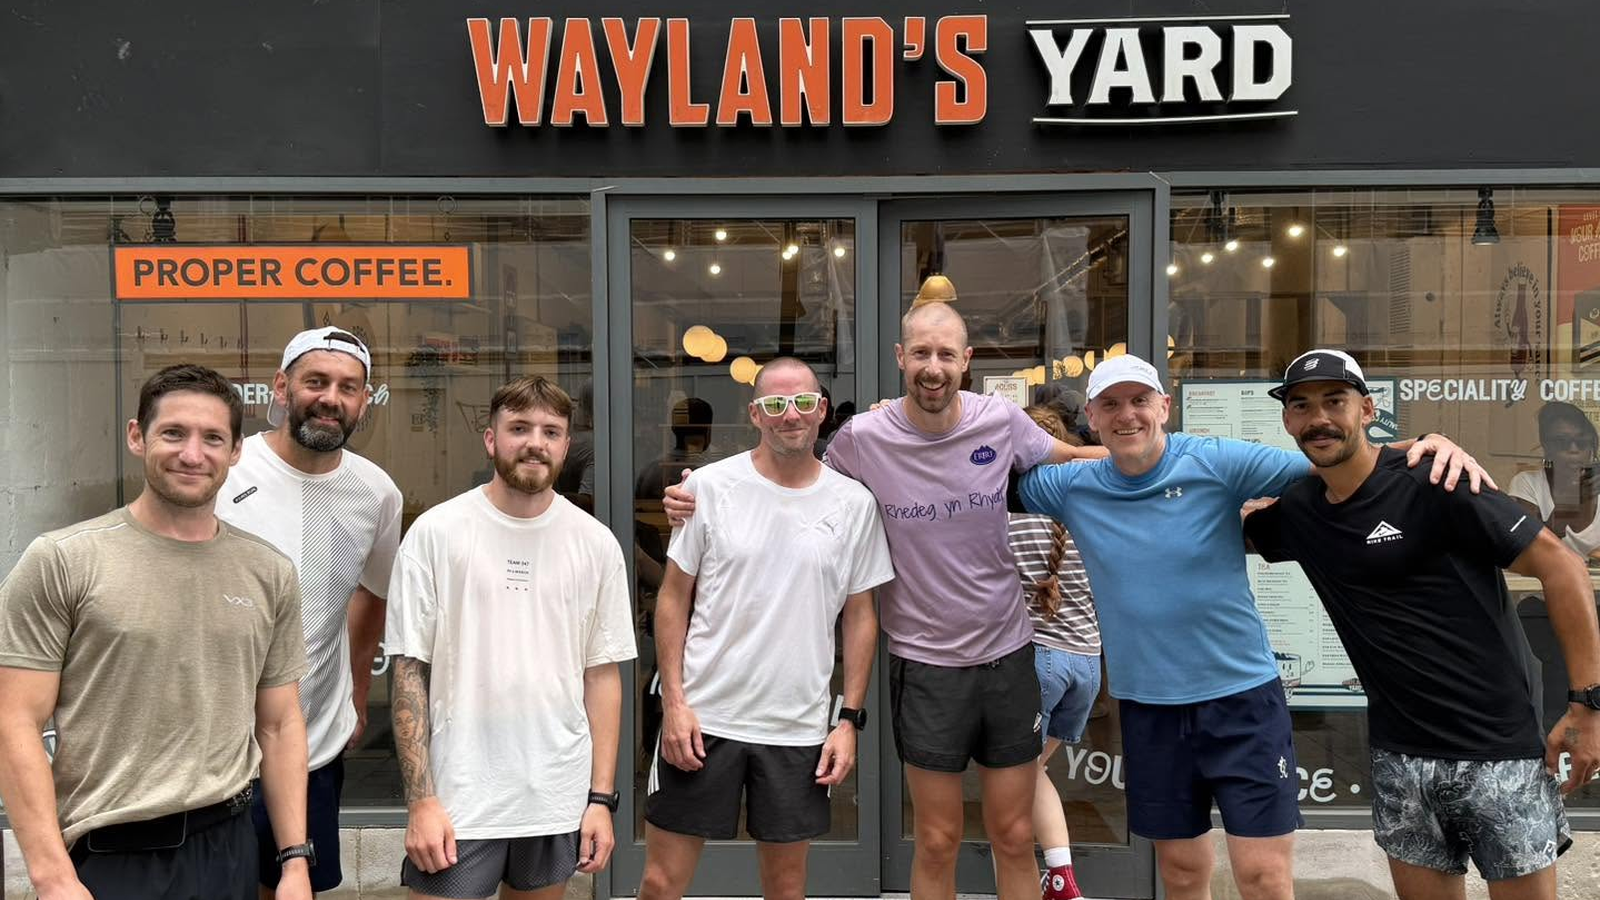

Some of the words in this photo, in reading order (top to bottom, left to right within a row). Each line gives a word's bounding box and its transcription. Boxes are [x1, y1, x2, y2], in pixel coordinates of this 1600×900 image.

[466, 15, 989, 128] WAYLAND'S
[1030, 24, 1293, 107] YARD
[133, 258, 282, 287] PROPER
[294, 257, 453, 287] COFFEE.
[1400, 379, 1528, 401] SPECIALITY
[884, 503, 936, 521] Rhedeg
